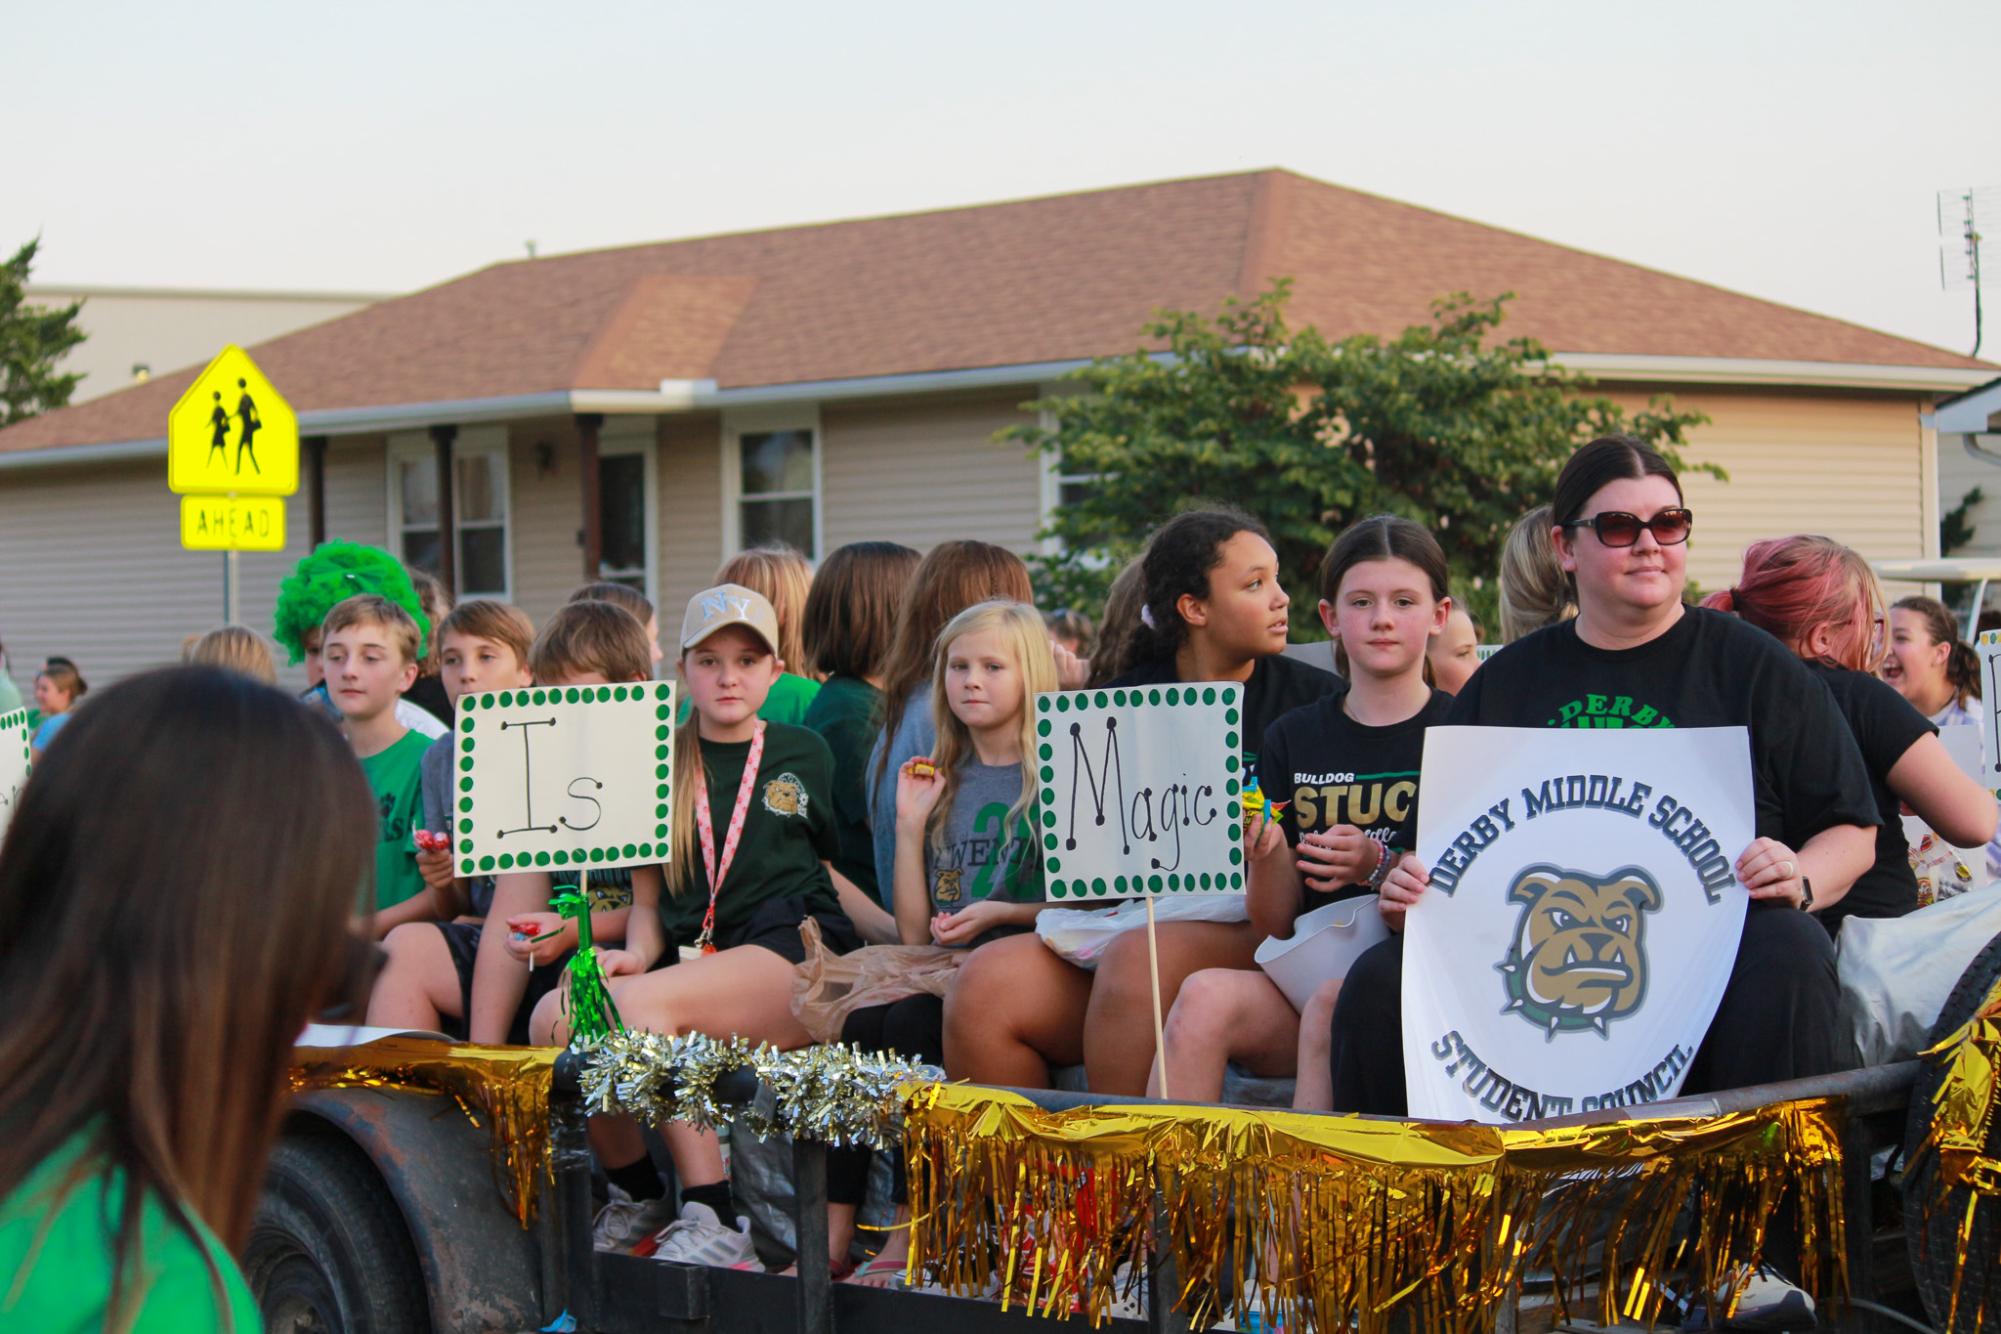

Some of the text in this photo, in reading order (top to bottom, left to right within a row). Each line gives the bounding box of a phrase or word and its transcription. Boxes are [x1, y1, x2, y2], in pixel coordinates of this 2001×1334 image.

[195, 507, 270, 538] AHEAD
[702, 591, 751, 621] NY
[496, 716, 603, 839] Is
[1065, 716, 1218, 872] Magic
[1293, 772, 1355, 785] BULLDOG
[1429, 774, 1737, 906] DERBY MIDDLE SCHOOL
[1430, 1030, 1574, 1123] STUDENT
